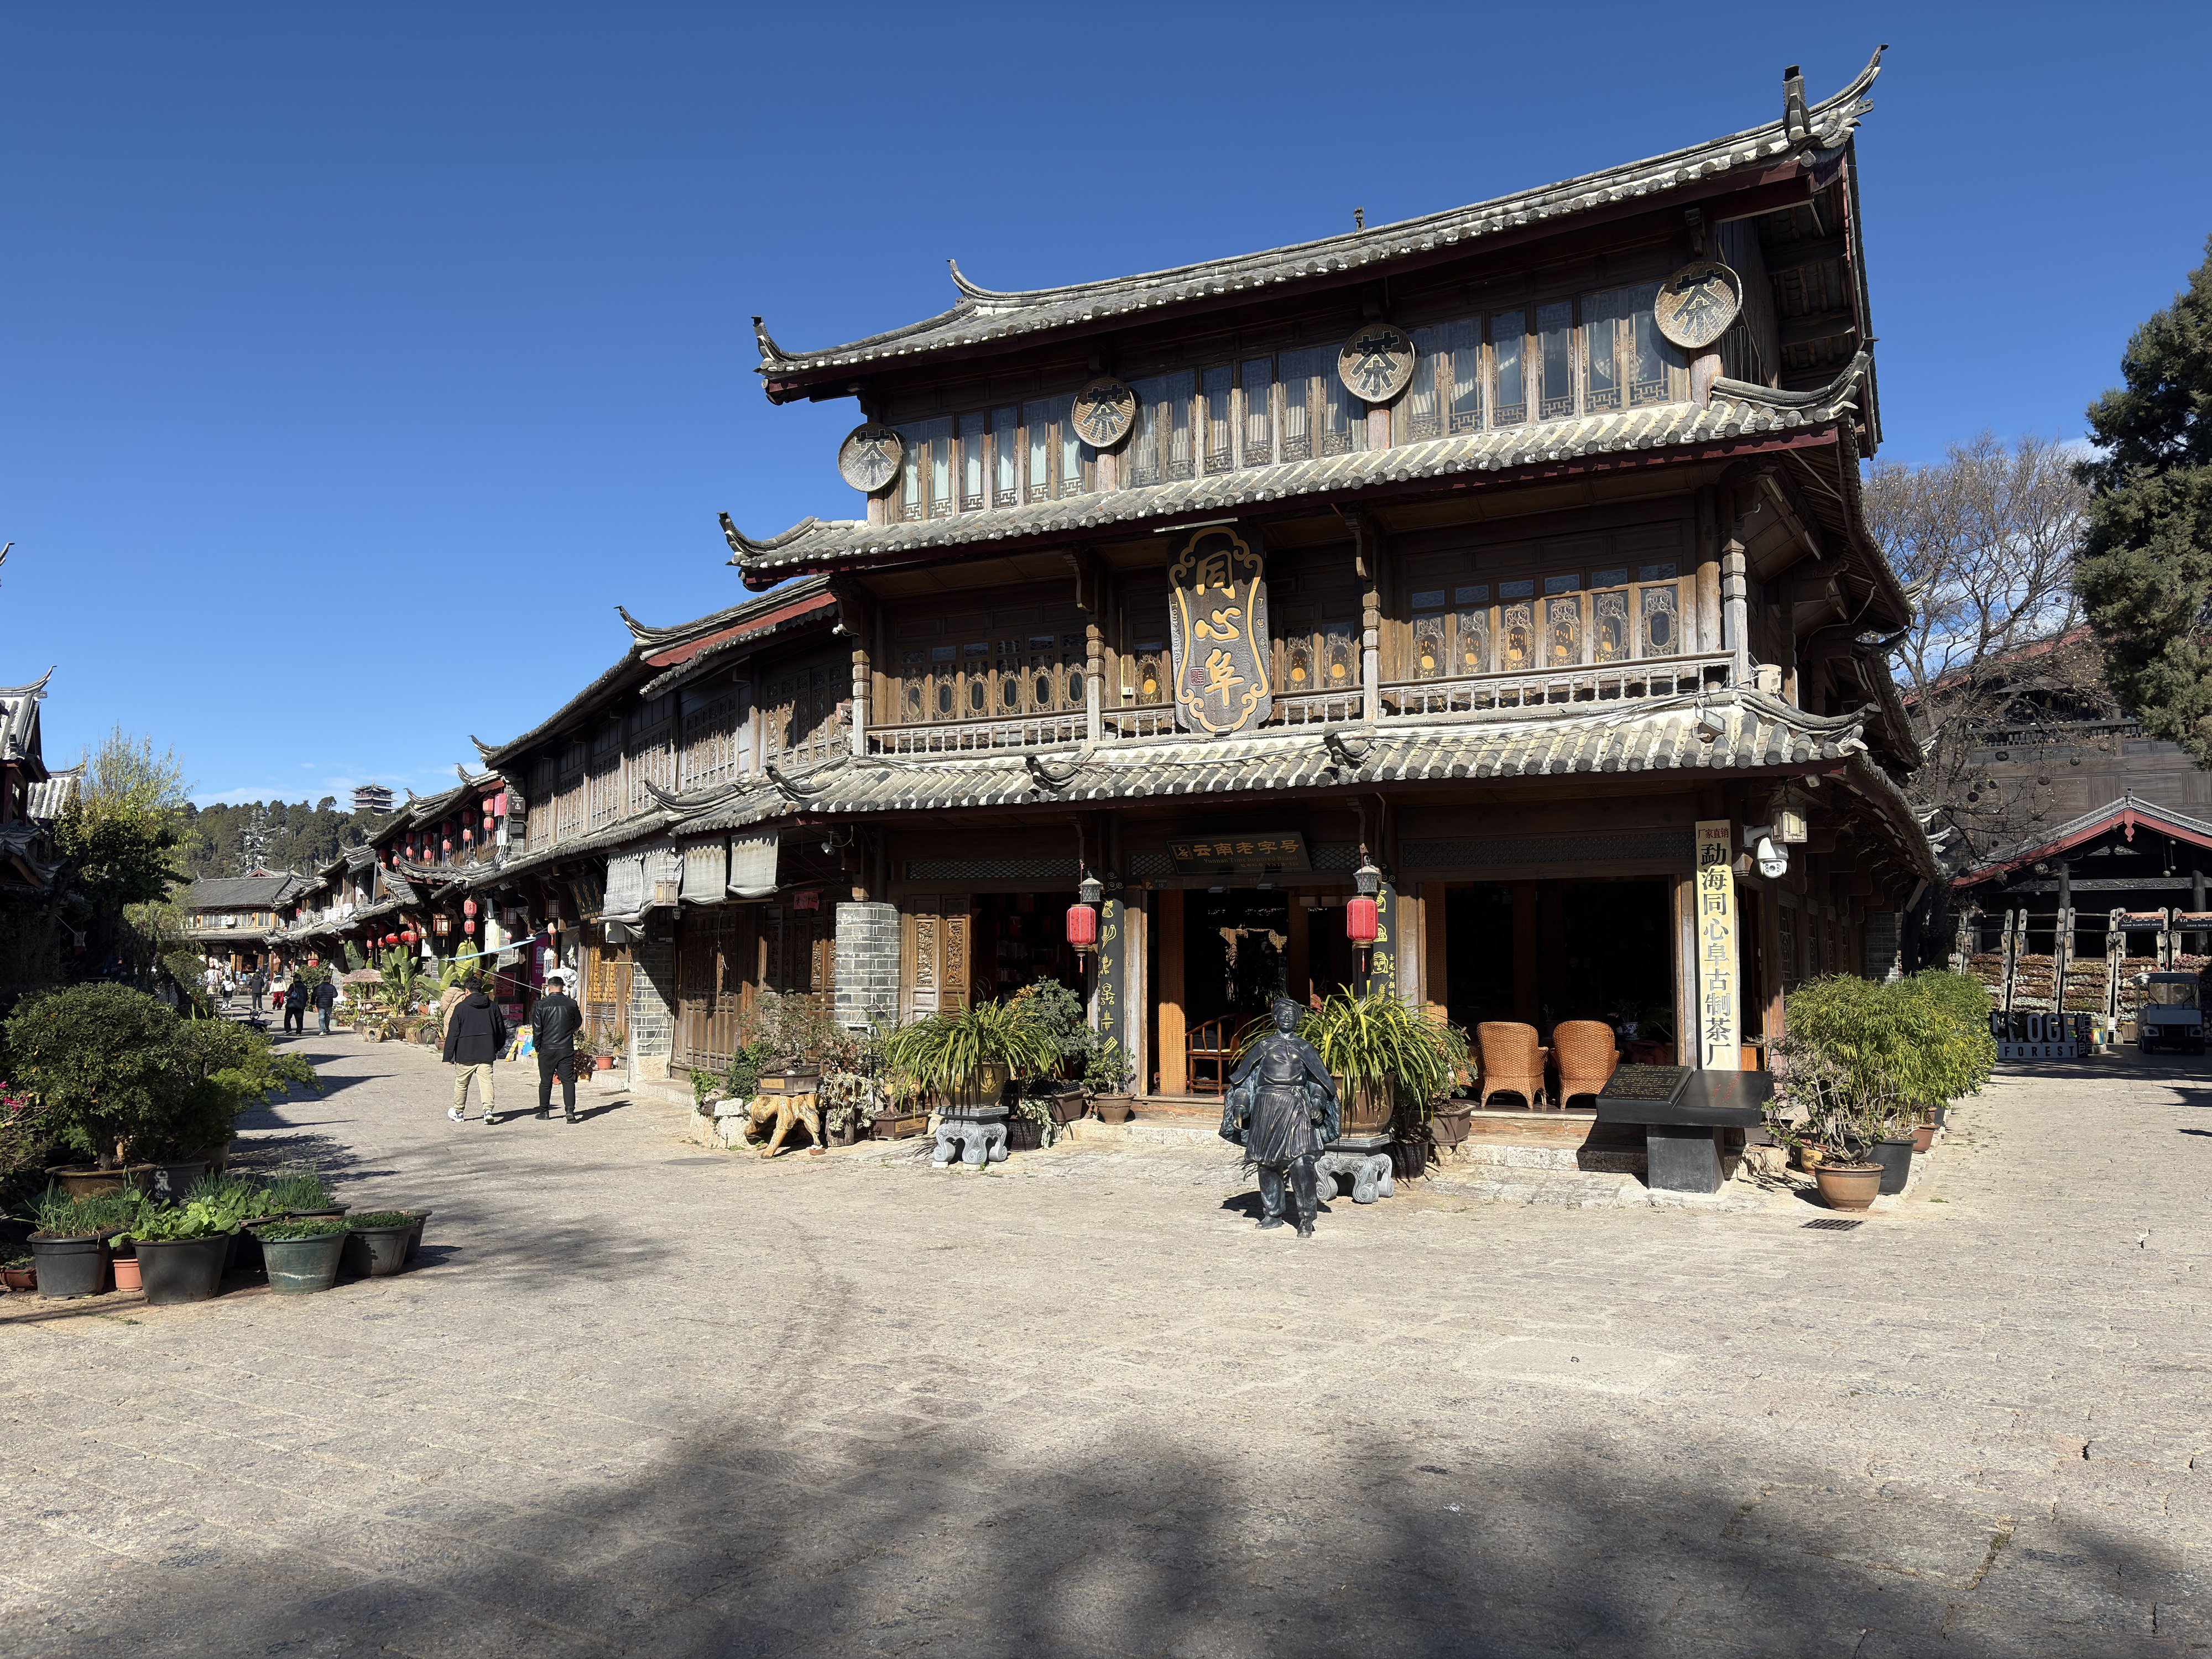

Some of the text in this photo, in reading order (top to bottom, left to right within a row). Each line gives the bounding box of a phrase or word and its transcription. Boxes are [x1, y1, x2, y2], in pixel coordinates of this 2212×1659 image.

[1671, 268, 1726, 345] 茶
[1350, 331, 1399, 399] 茶
[1082, 383, 1125, 446] 茶
[850, 429, 894, 489] 茶
[1172, 630, 1181, 647] Xin
[1194, 550, 1245, 707] 同心阜
[1193, 839, 1300, 857] 云南老字号
[1698, 827, 1729, 839] 厂家直销
[1701, 843, 1731, 1066] 勐海同心阜古制茶厂
[2005, 1046, 2074, 1057] FOREST
